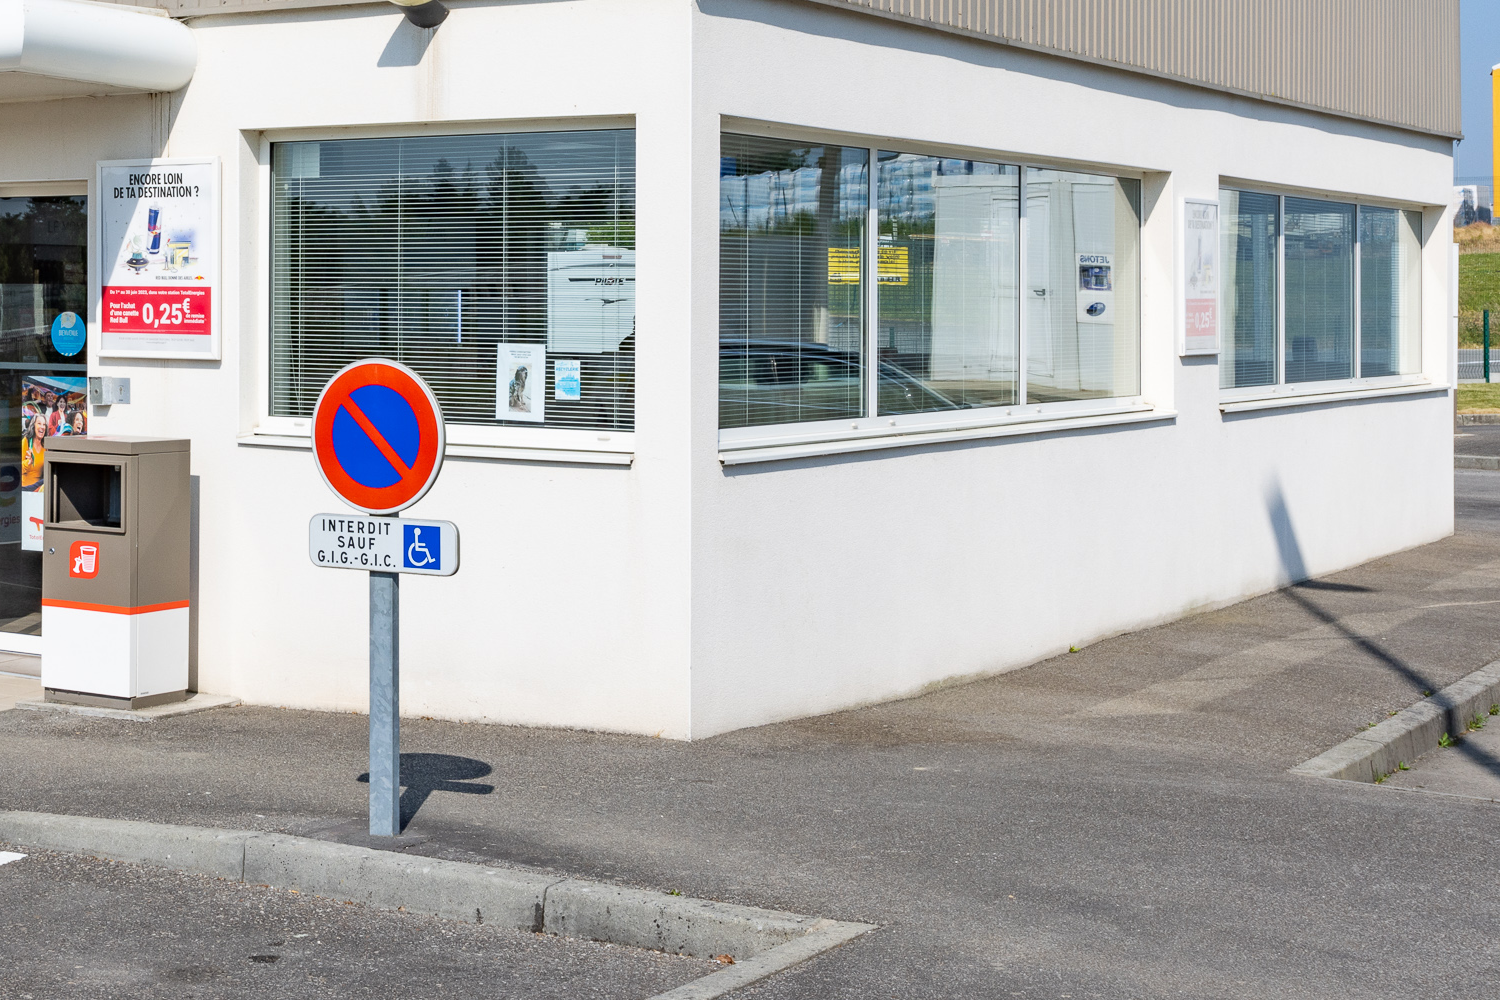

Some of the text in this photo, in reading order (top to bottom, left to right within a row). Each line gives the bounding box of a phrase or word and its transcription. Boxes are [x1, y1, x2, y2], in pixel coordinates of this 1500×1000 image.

[129, 172, 183, 186] ENCORE LOIN
[113, 186, 199, 199] DE TA DESTINATION ?
[142, 298, 191, 329] 0,25€
[322, 518, 391, 536] INTERDIT
[337, 535, 376, 550] SAUF
[317, 550, 396, 568] G.I.G.-G.I.C.
